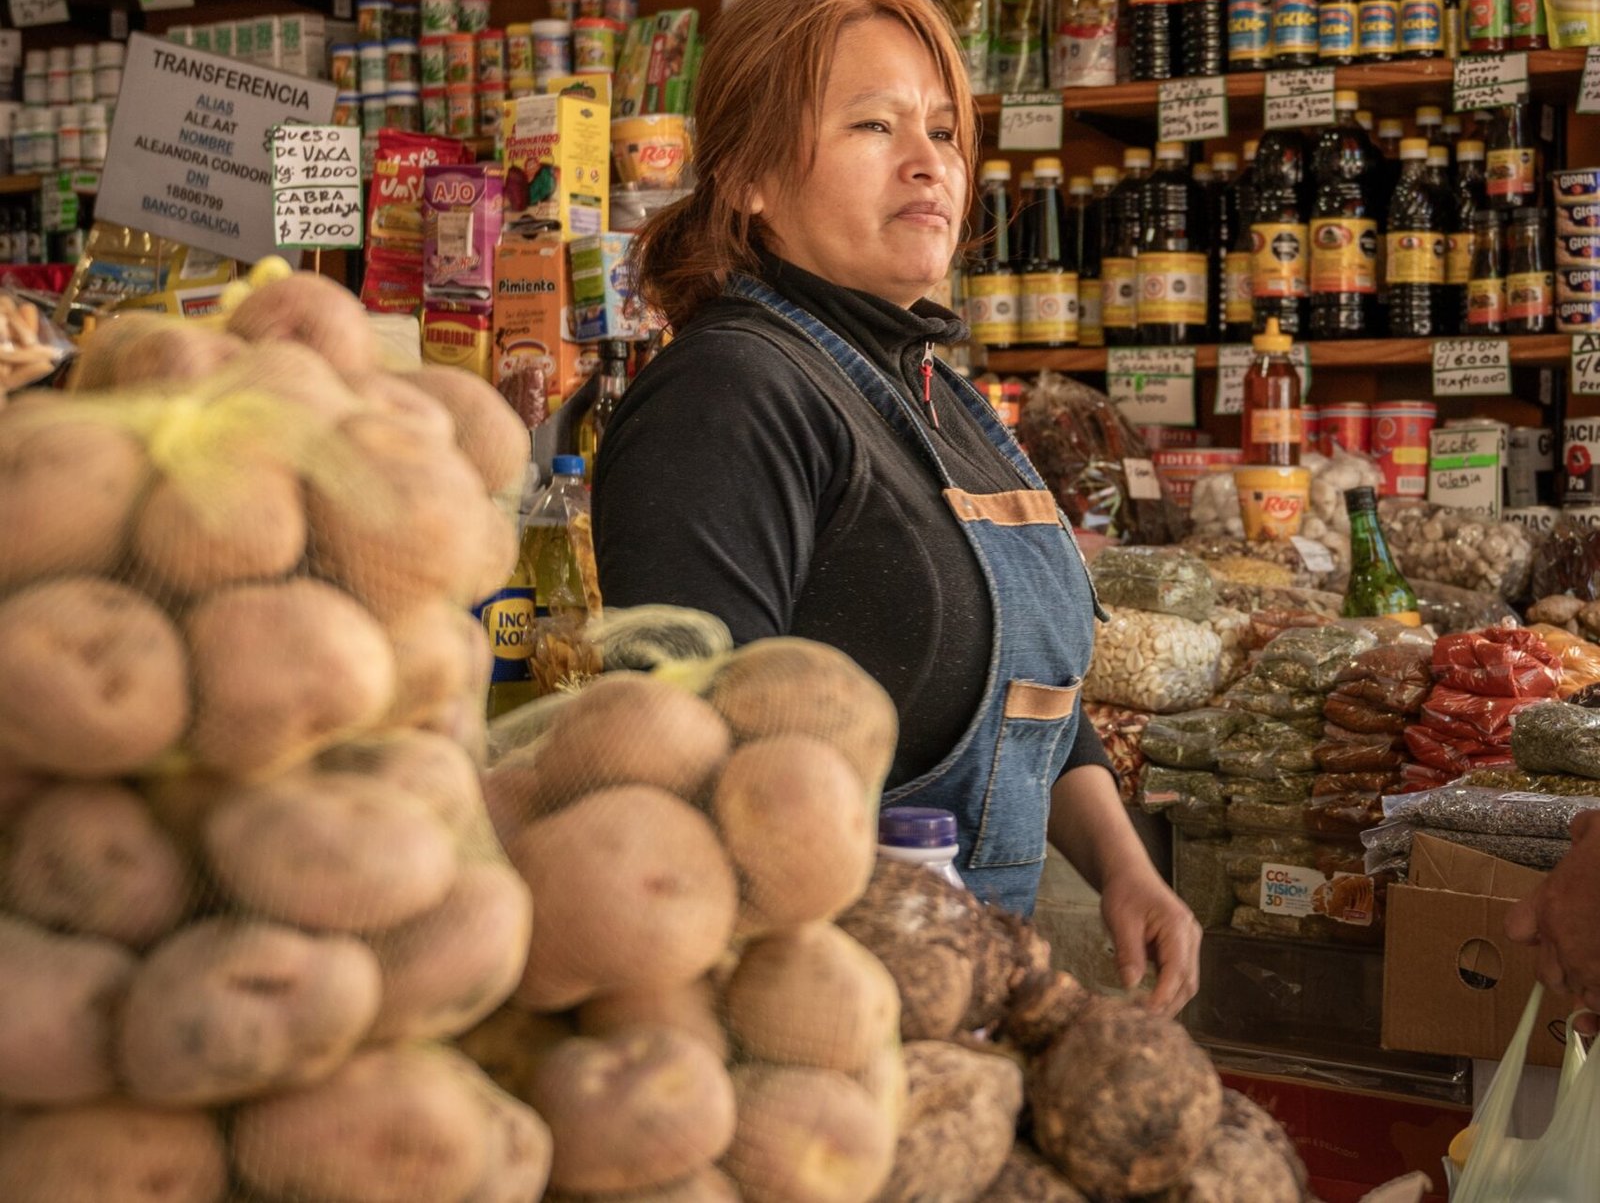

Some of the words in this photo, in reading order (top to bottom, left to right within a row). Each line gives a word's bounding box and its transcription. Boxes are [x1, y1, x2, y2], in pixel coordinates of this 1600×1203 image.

[152, 48, 311, 111] TRANSFERENCIA
[195, 93, 235, 116] ALIAS
[178, 127, 235, 156] NOMBRE
[134, 134, 209, 169] ALEJANDRA
[210, 158, 273, 187] CONDORI
[302, 145, 352, 163] VACA
[185, 168, 210, 188] DNI
[1559, 174, 1597, 190] GLORIA
[275, 189, 345, 205] CABRA
[431, 180, 477, 204] AJO
[141, 194, 188, 221] BANCO
[189, 209, 241, 238] GALICIA
[278, 219, 292, 245] $
[298, 220, 356, 241] 7.000
[498, 278, 556, 296] Pimienta
[1560, 302, 1596, 318] GLORIA
[1265, 894, 1283, 907] 3D
